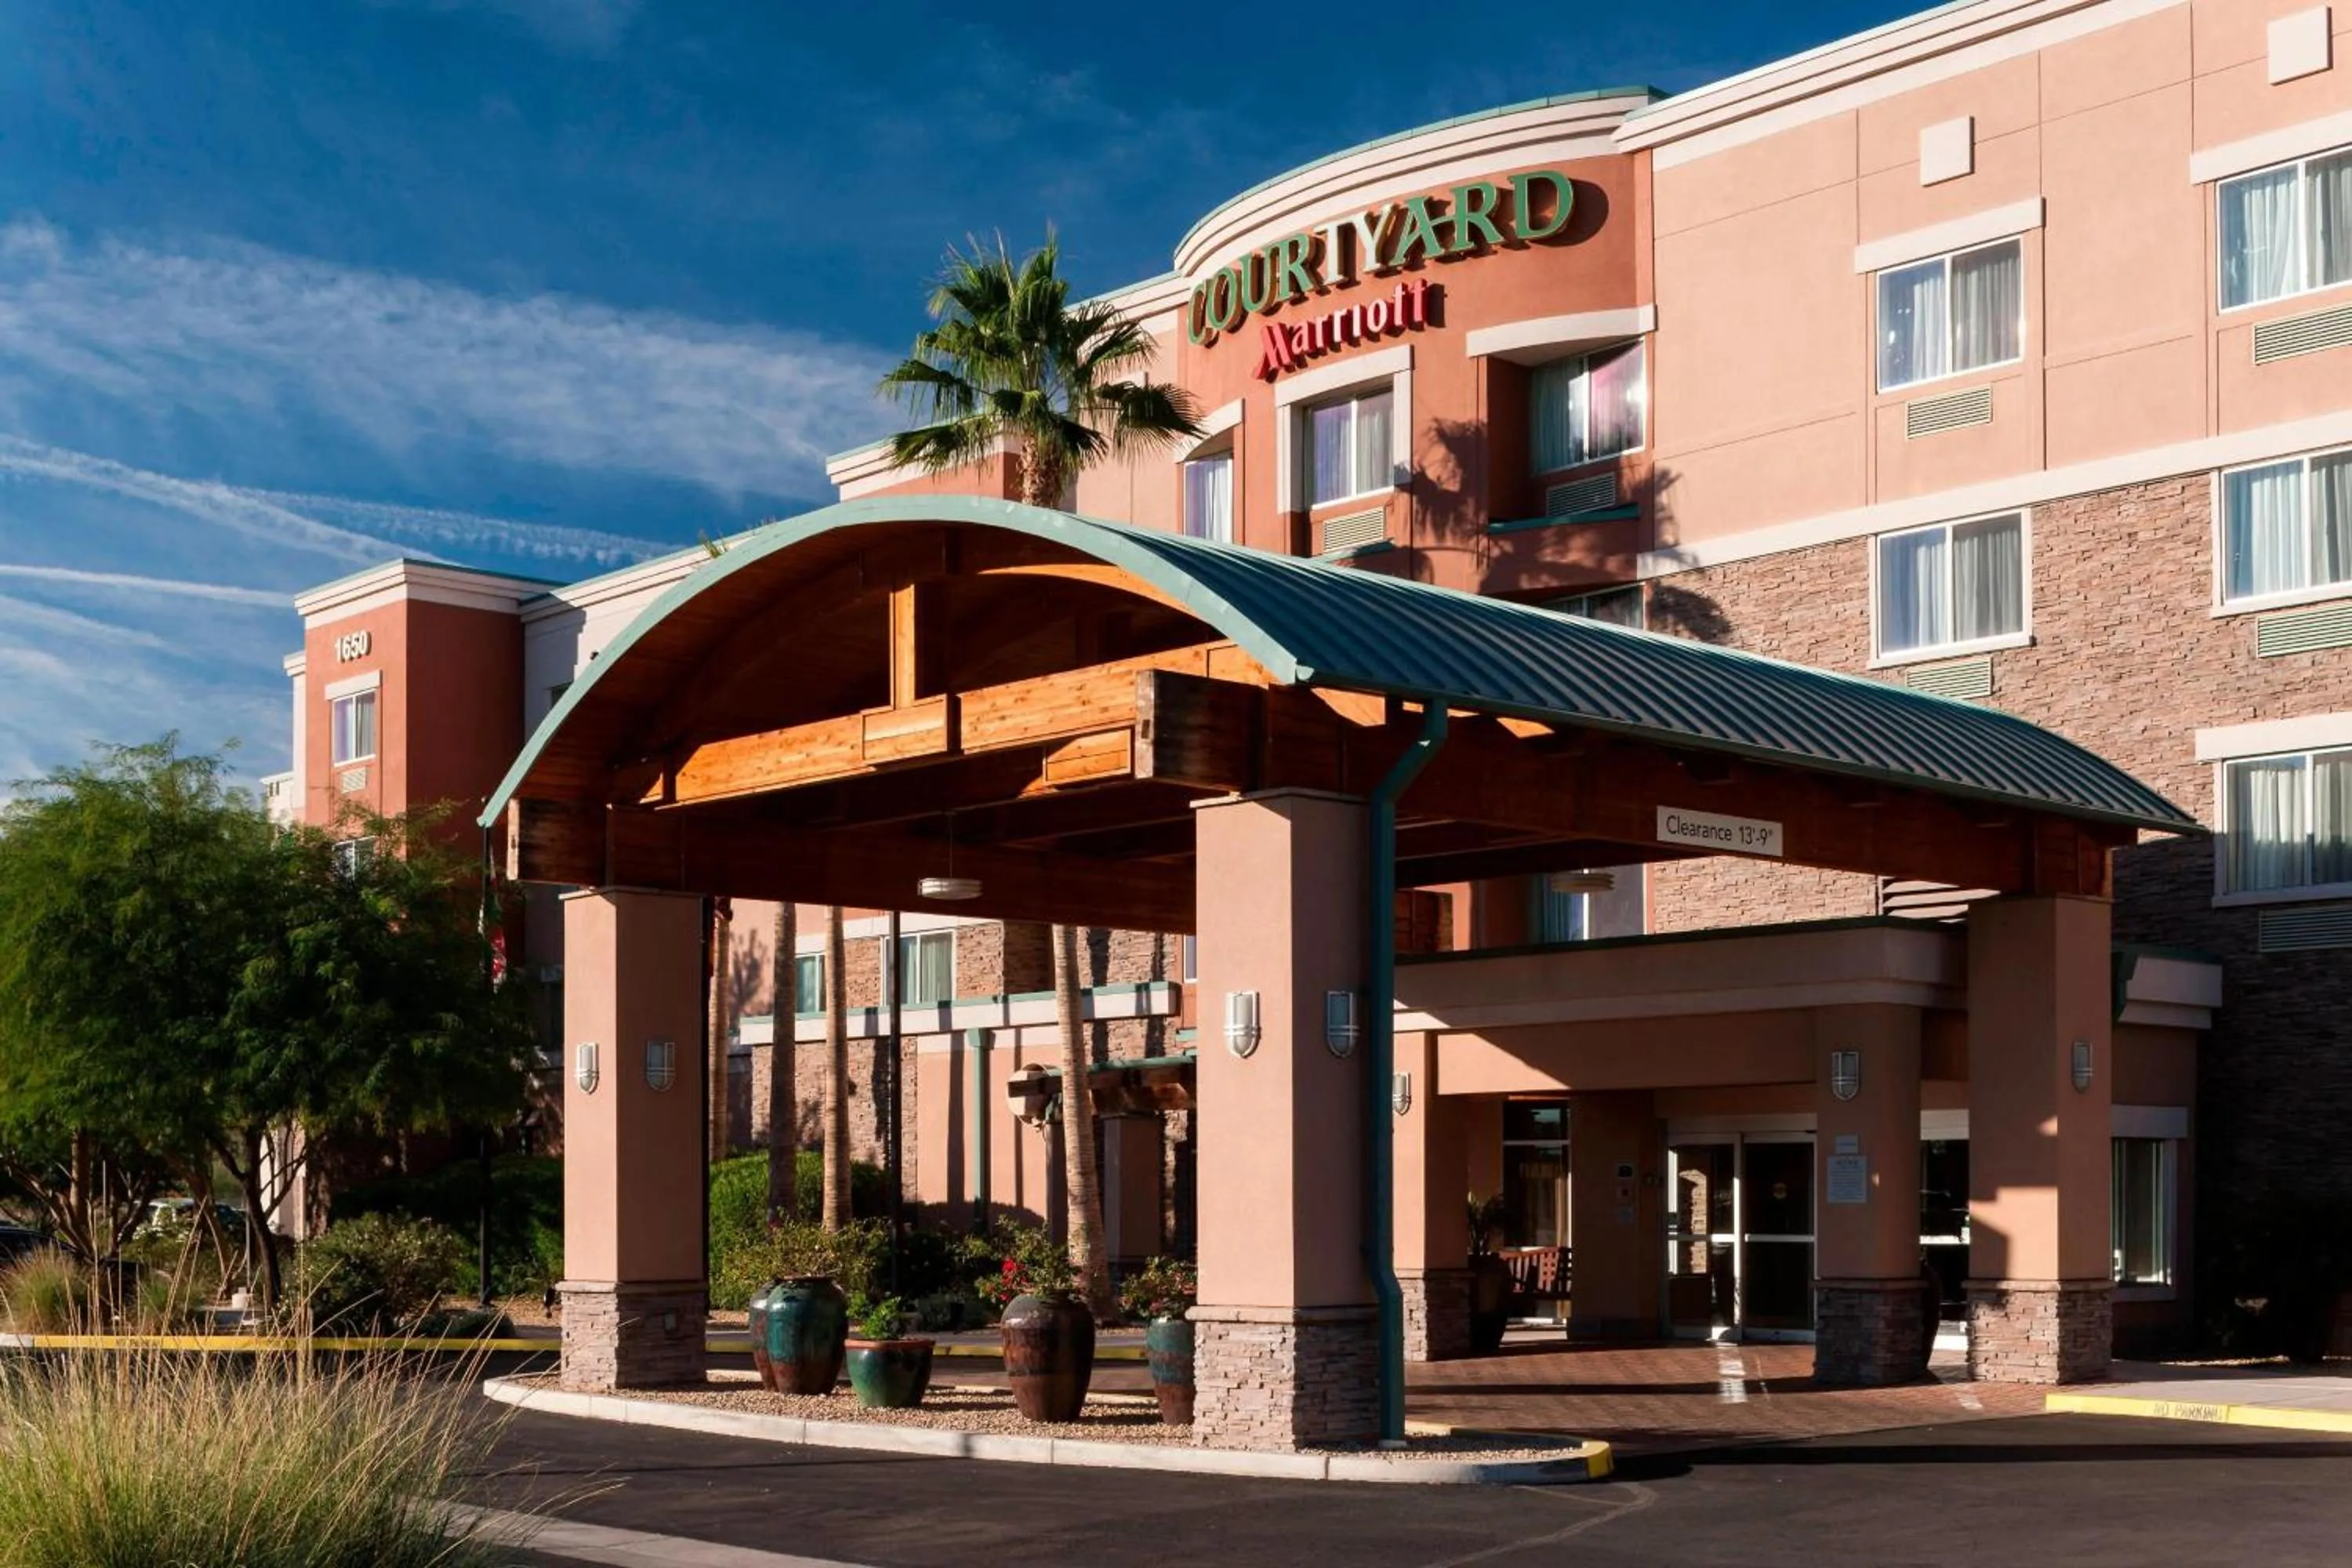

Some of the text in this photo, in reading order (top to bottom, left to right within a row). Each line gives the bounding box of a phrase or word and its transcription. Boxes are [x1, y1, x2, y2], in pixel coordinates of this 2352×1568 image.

[1187, 169, 1576, 347] COURTYARD
[1252, 278, 1428, 379] Marriott
[335, 630, 368, 662] 1650
[1666, 815, 1733, 842] Clearance
